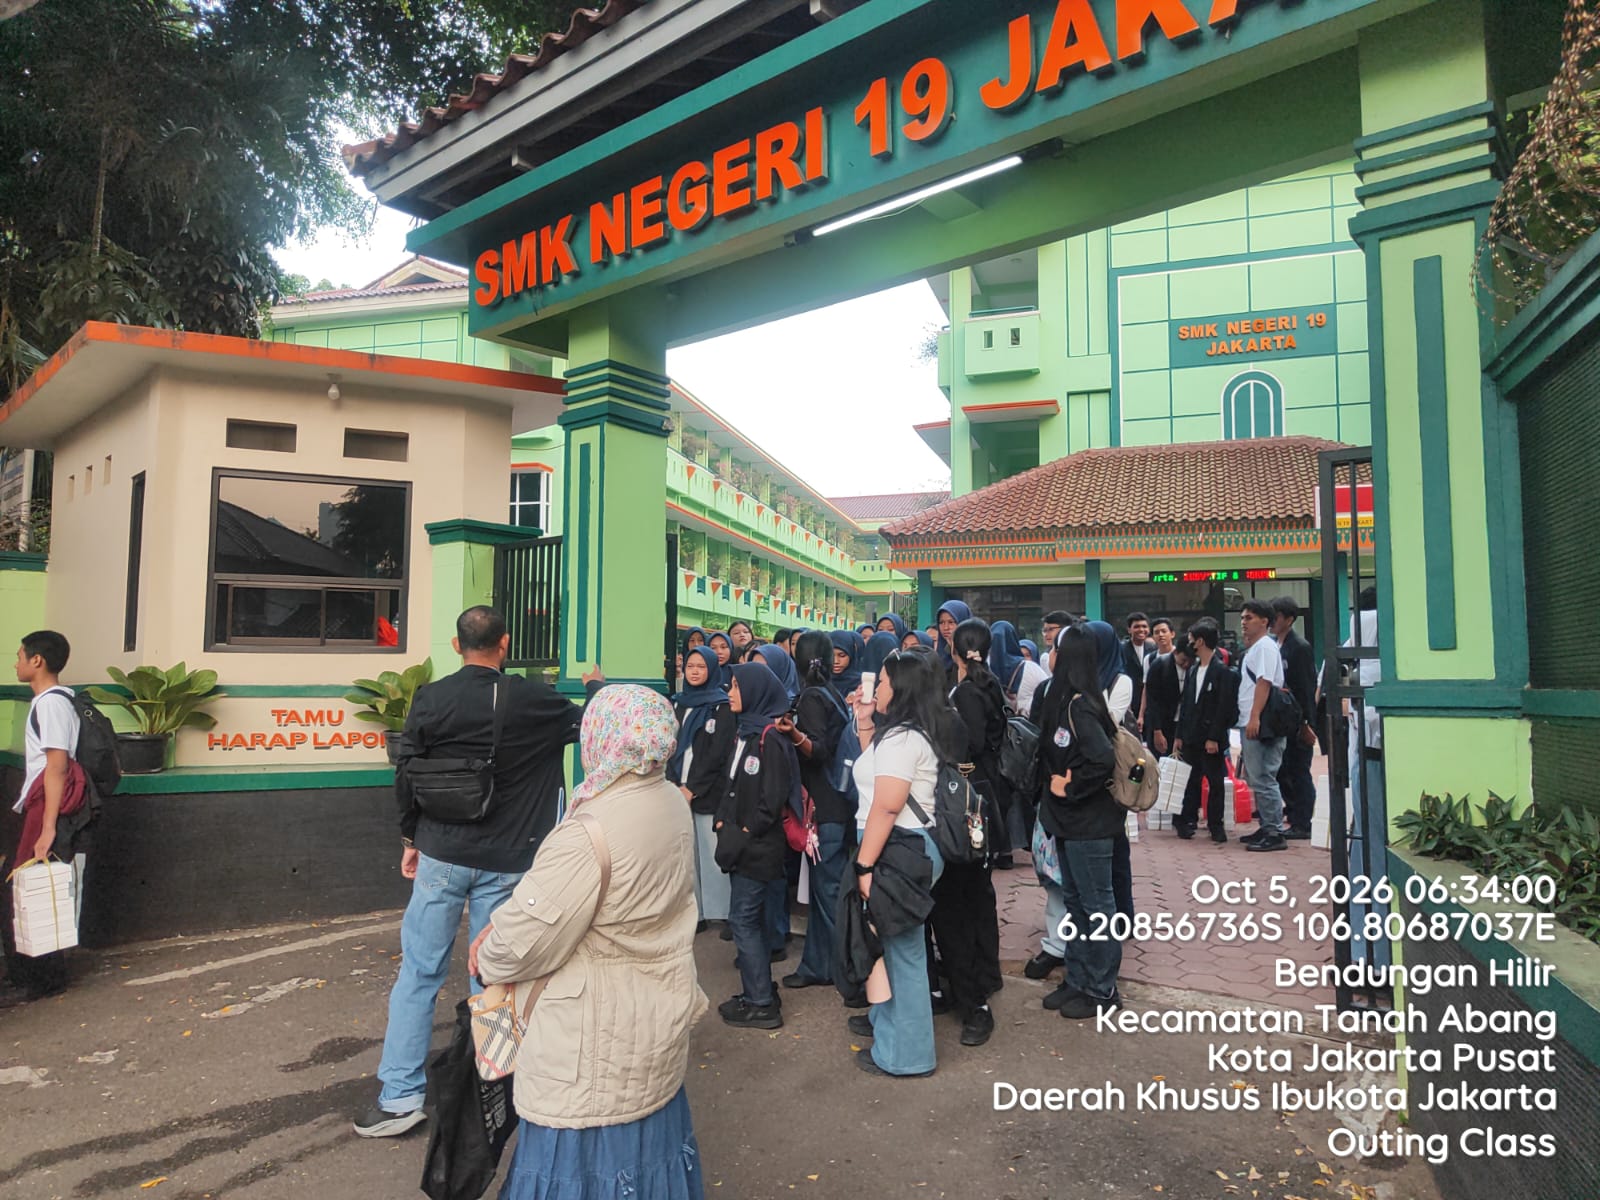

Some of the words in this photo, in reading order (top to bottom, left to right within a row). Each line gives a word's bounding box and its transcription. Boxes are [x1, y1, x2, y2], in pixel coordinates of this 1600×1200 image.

[474, 213, 580, 308] SMK
[589, 106, 825, 264] NEGERI
[854, 57, 949, 157] 19
[1178, 323, 1218, 339] SMK
[1227, 315, 1297, 335] NEGERI
[1306, 312, 1327, 328] 19
[1206, 335, 1296, 356] JAKARTA
[271, 709, 345, 727] TAMU
[207, 732, 308, 750] HARAP
